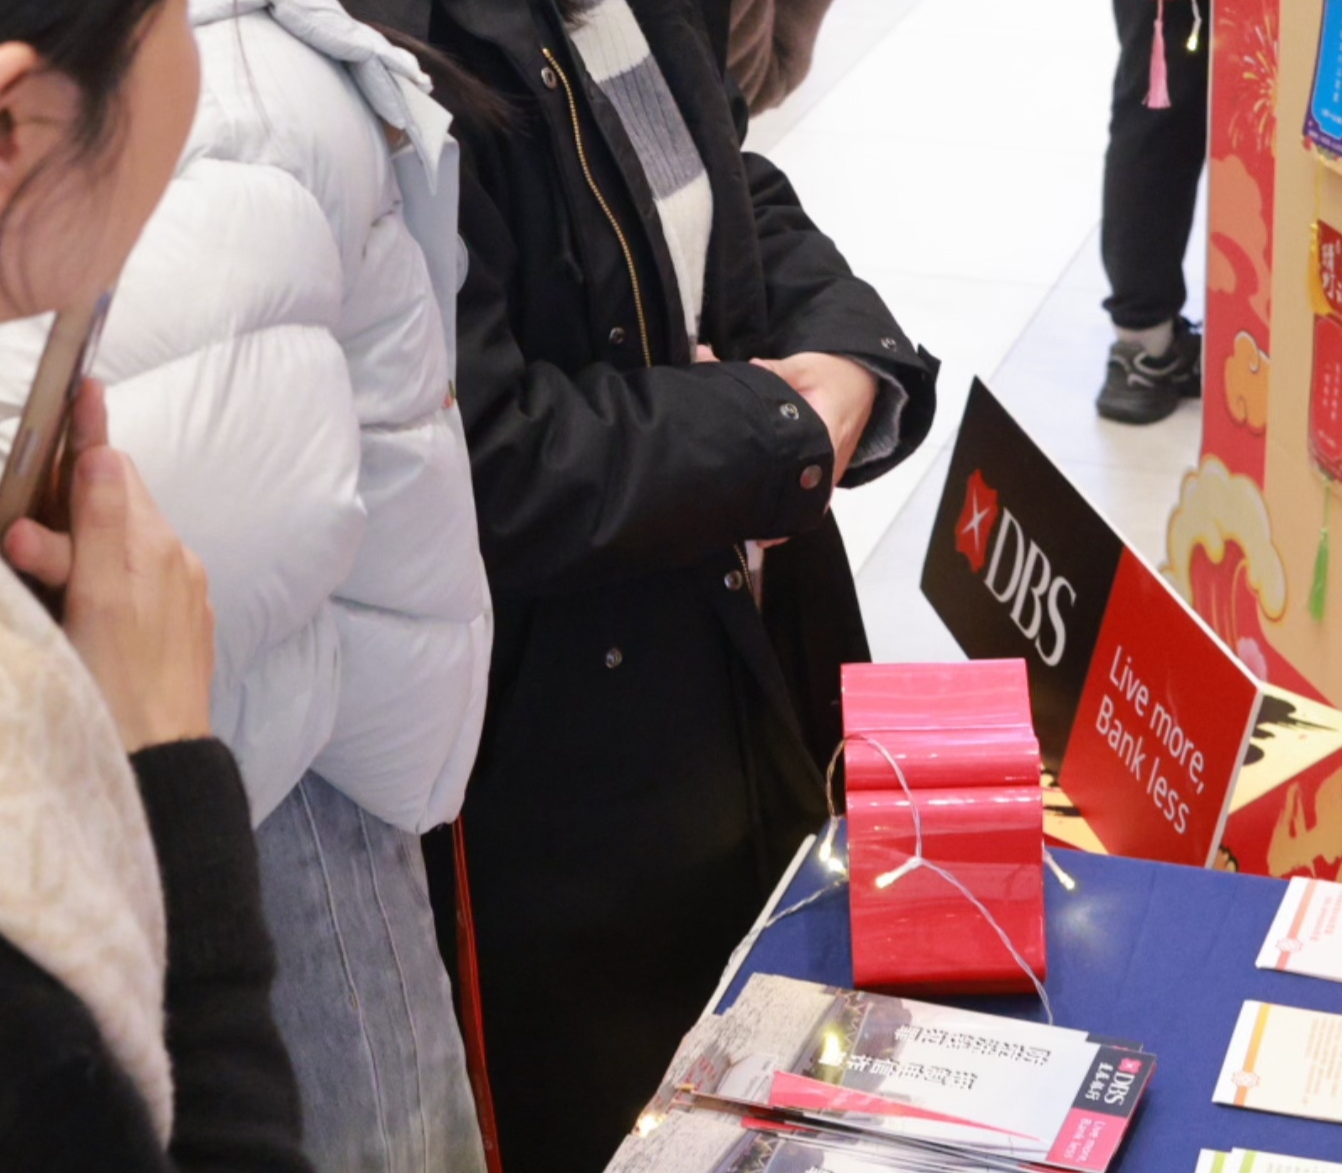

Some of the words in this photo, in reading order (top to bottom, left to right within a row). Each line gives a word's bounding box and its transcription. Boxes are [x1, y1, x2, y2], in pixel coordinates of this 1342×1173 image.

[984, 507, 1077, 667] DBS
[1095, 694, 1147, 782] Bank
[1146, 757, 1191, 835] less
[1109, 645, 1149, 718] Live
[1151, 699, 1206, 794] more,
[1102, 1071, 1136, 1106] DBS
